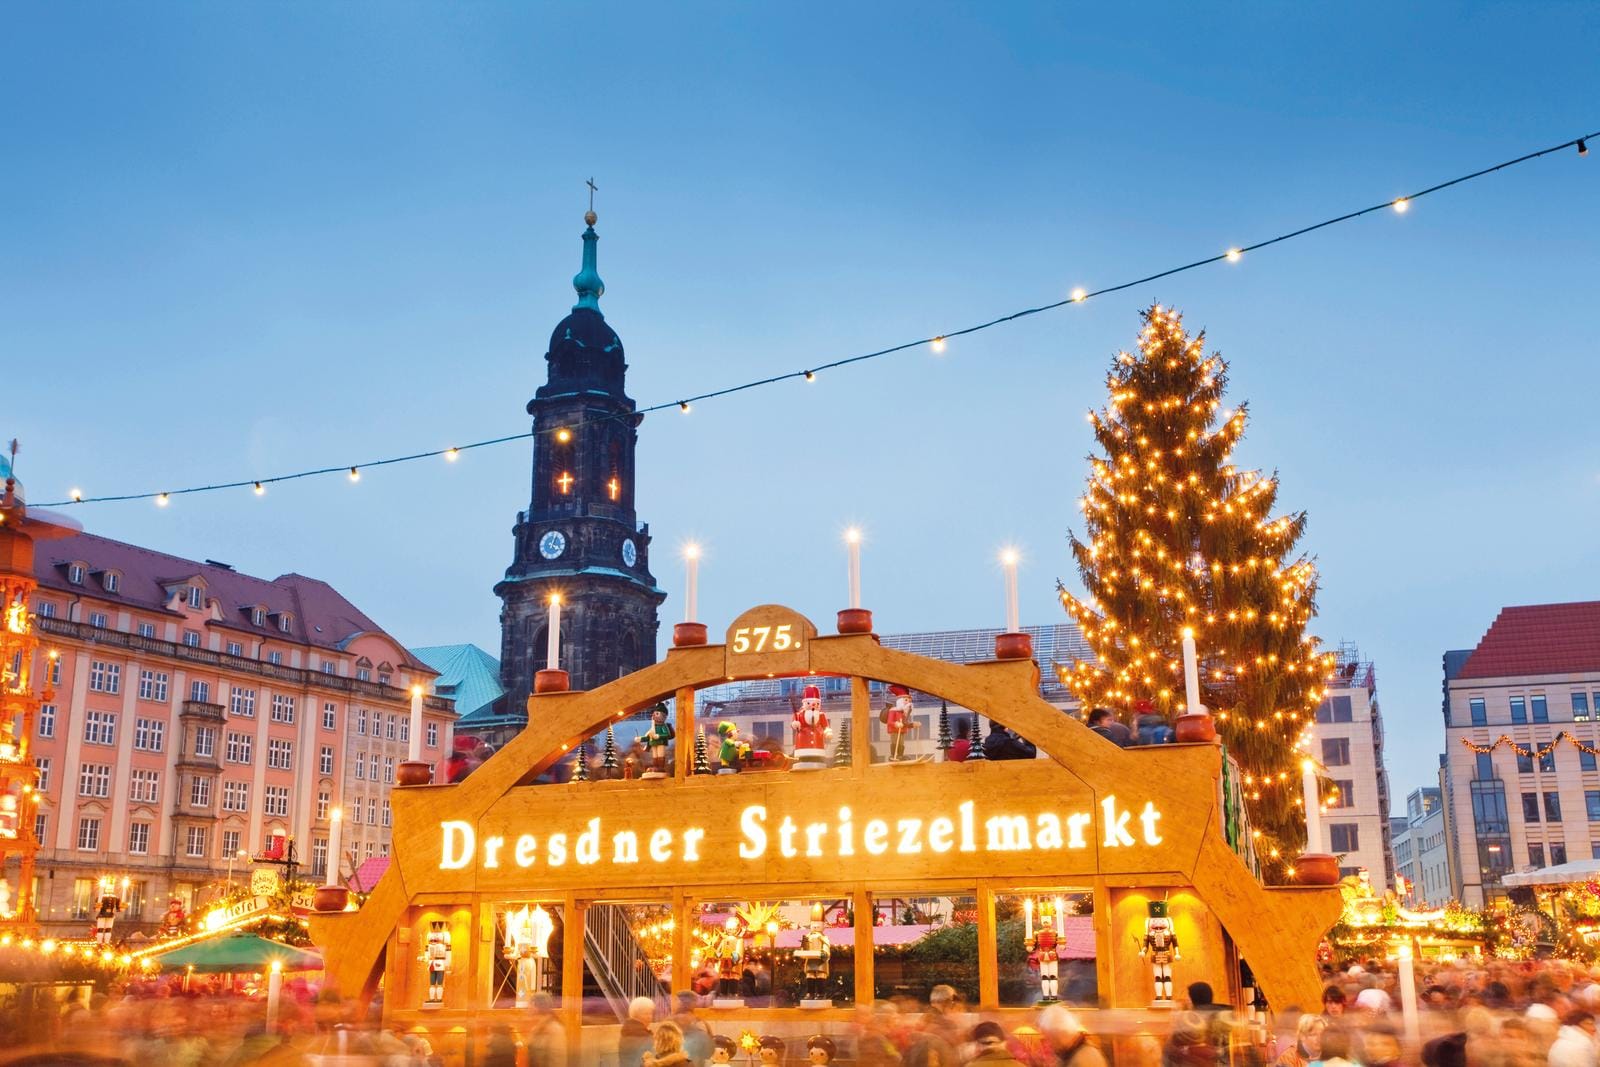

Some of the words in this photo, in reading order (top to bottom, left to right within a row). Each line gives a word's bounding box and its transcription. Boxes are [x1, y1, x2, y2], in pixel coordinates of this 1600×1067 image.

[732, 624, 801, 652] 575.
[439, 817, 705, 869] Dresdner
[739, 792, 1163, 859] Striezelmarkt
